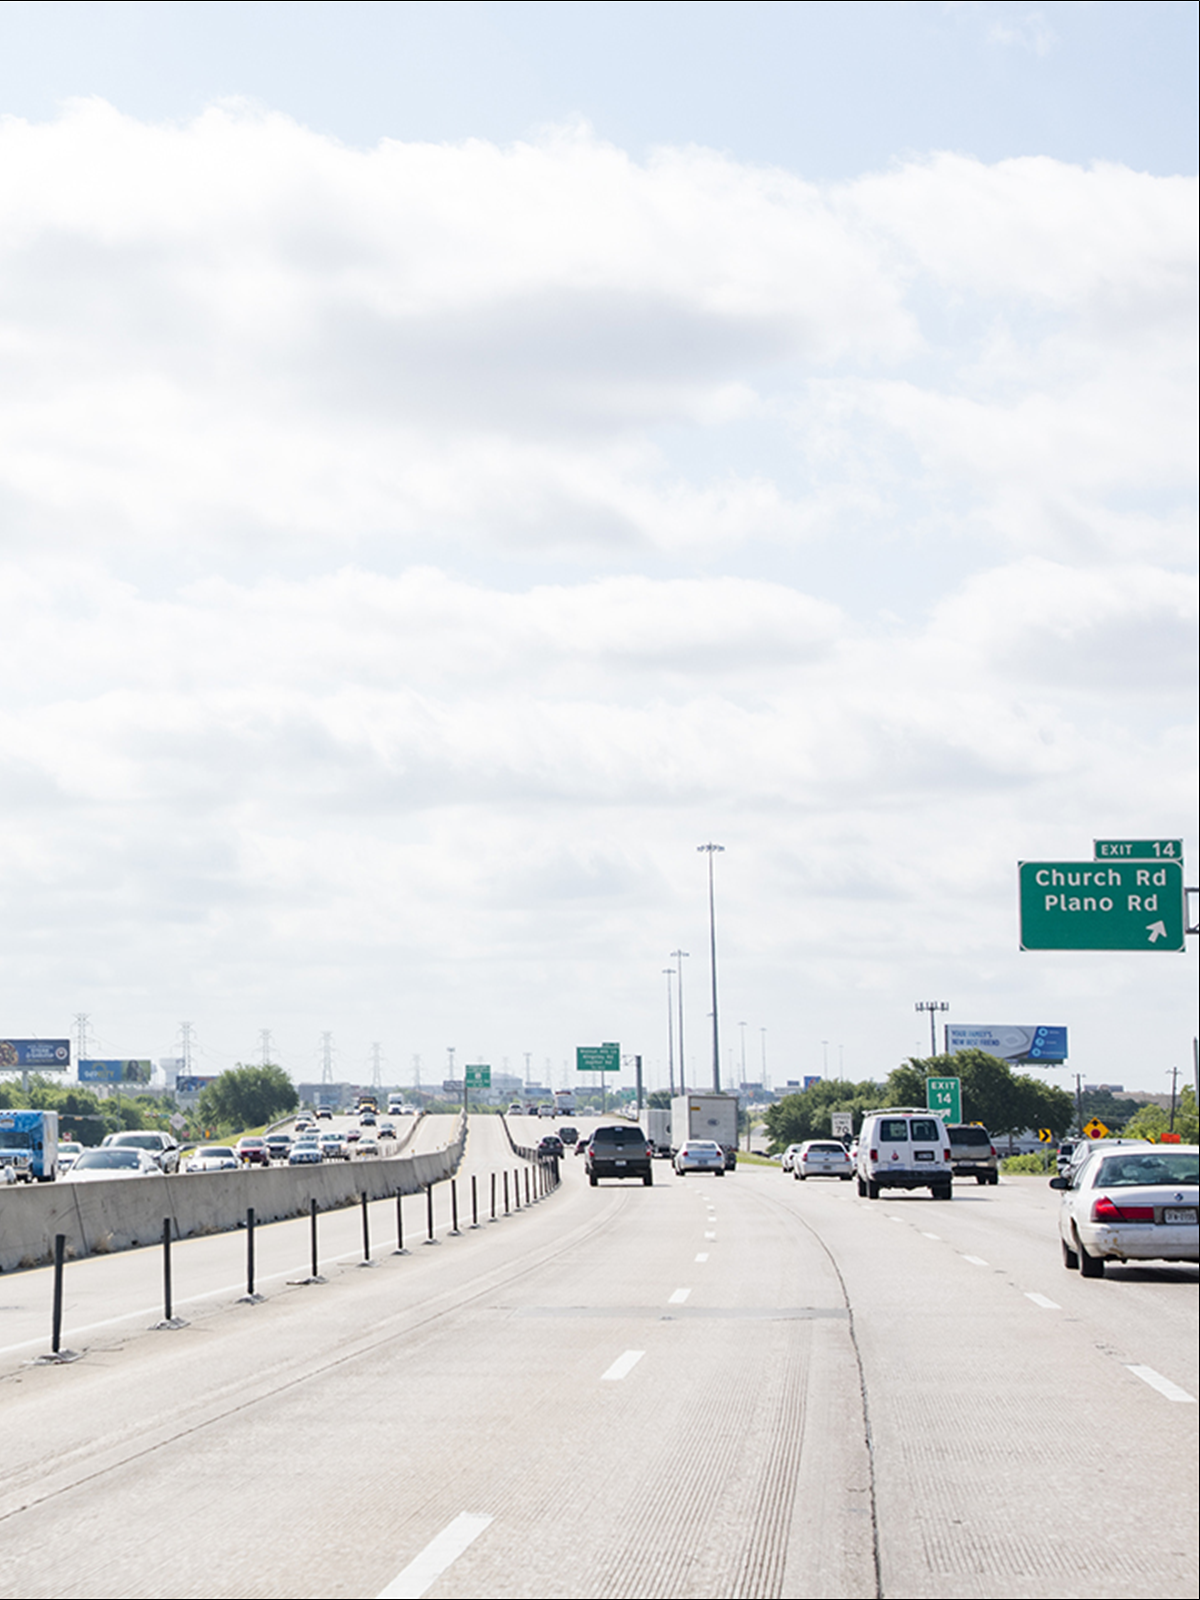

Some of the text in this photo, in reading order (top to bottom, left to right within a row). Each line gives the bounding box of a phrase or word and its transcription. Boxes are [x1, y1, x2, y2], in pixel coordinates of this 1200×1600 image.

[1101, 842, 1175, 857] EXIT 14
[1035, 869, 1167, 886] Church Rd
[1045, 894, 1158, 911] Plano Rd
[931, 1082, 955, 1090] EXIT
[936, 1093, 952, 1104] 14
[835, 1126, 850, 1134] 70
